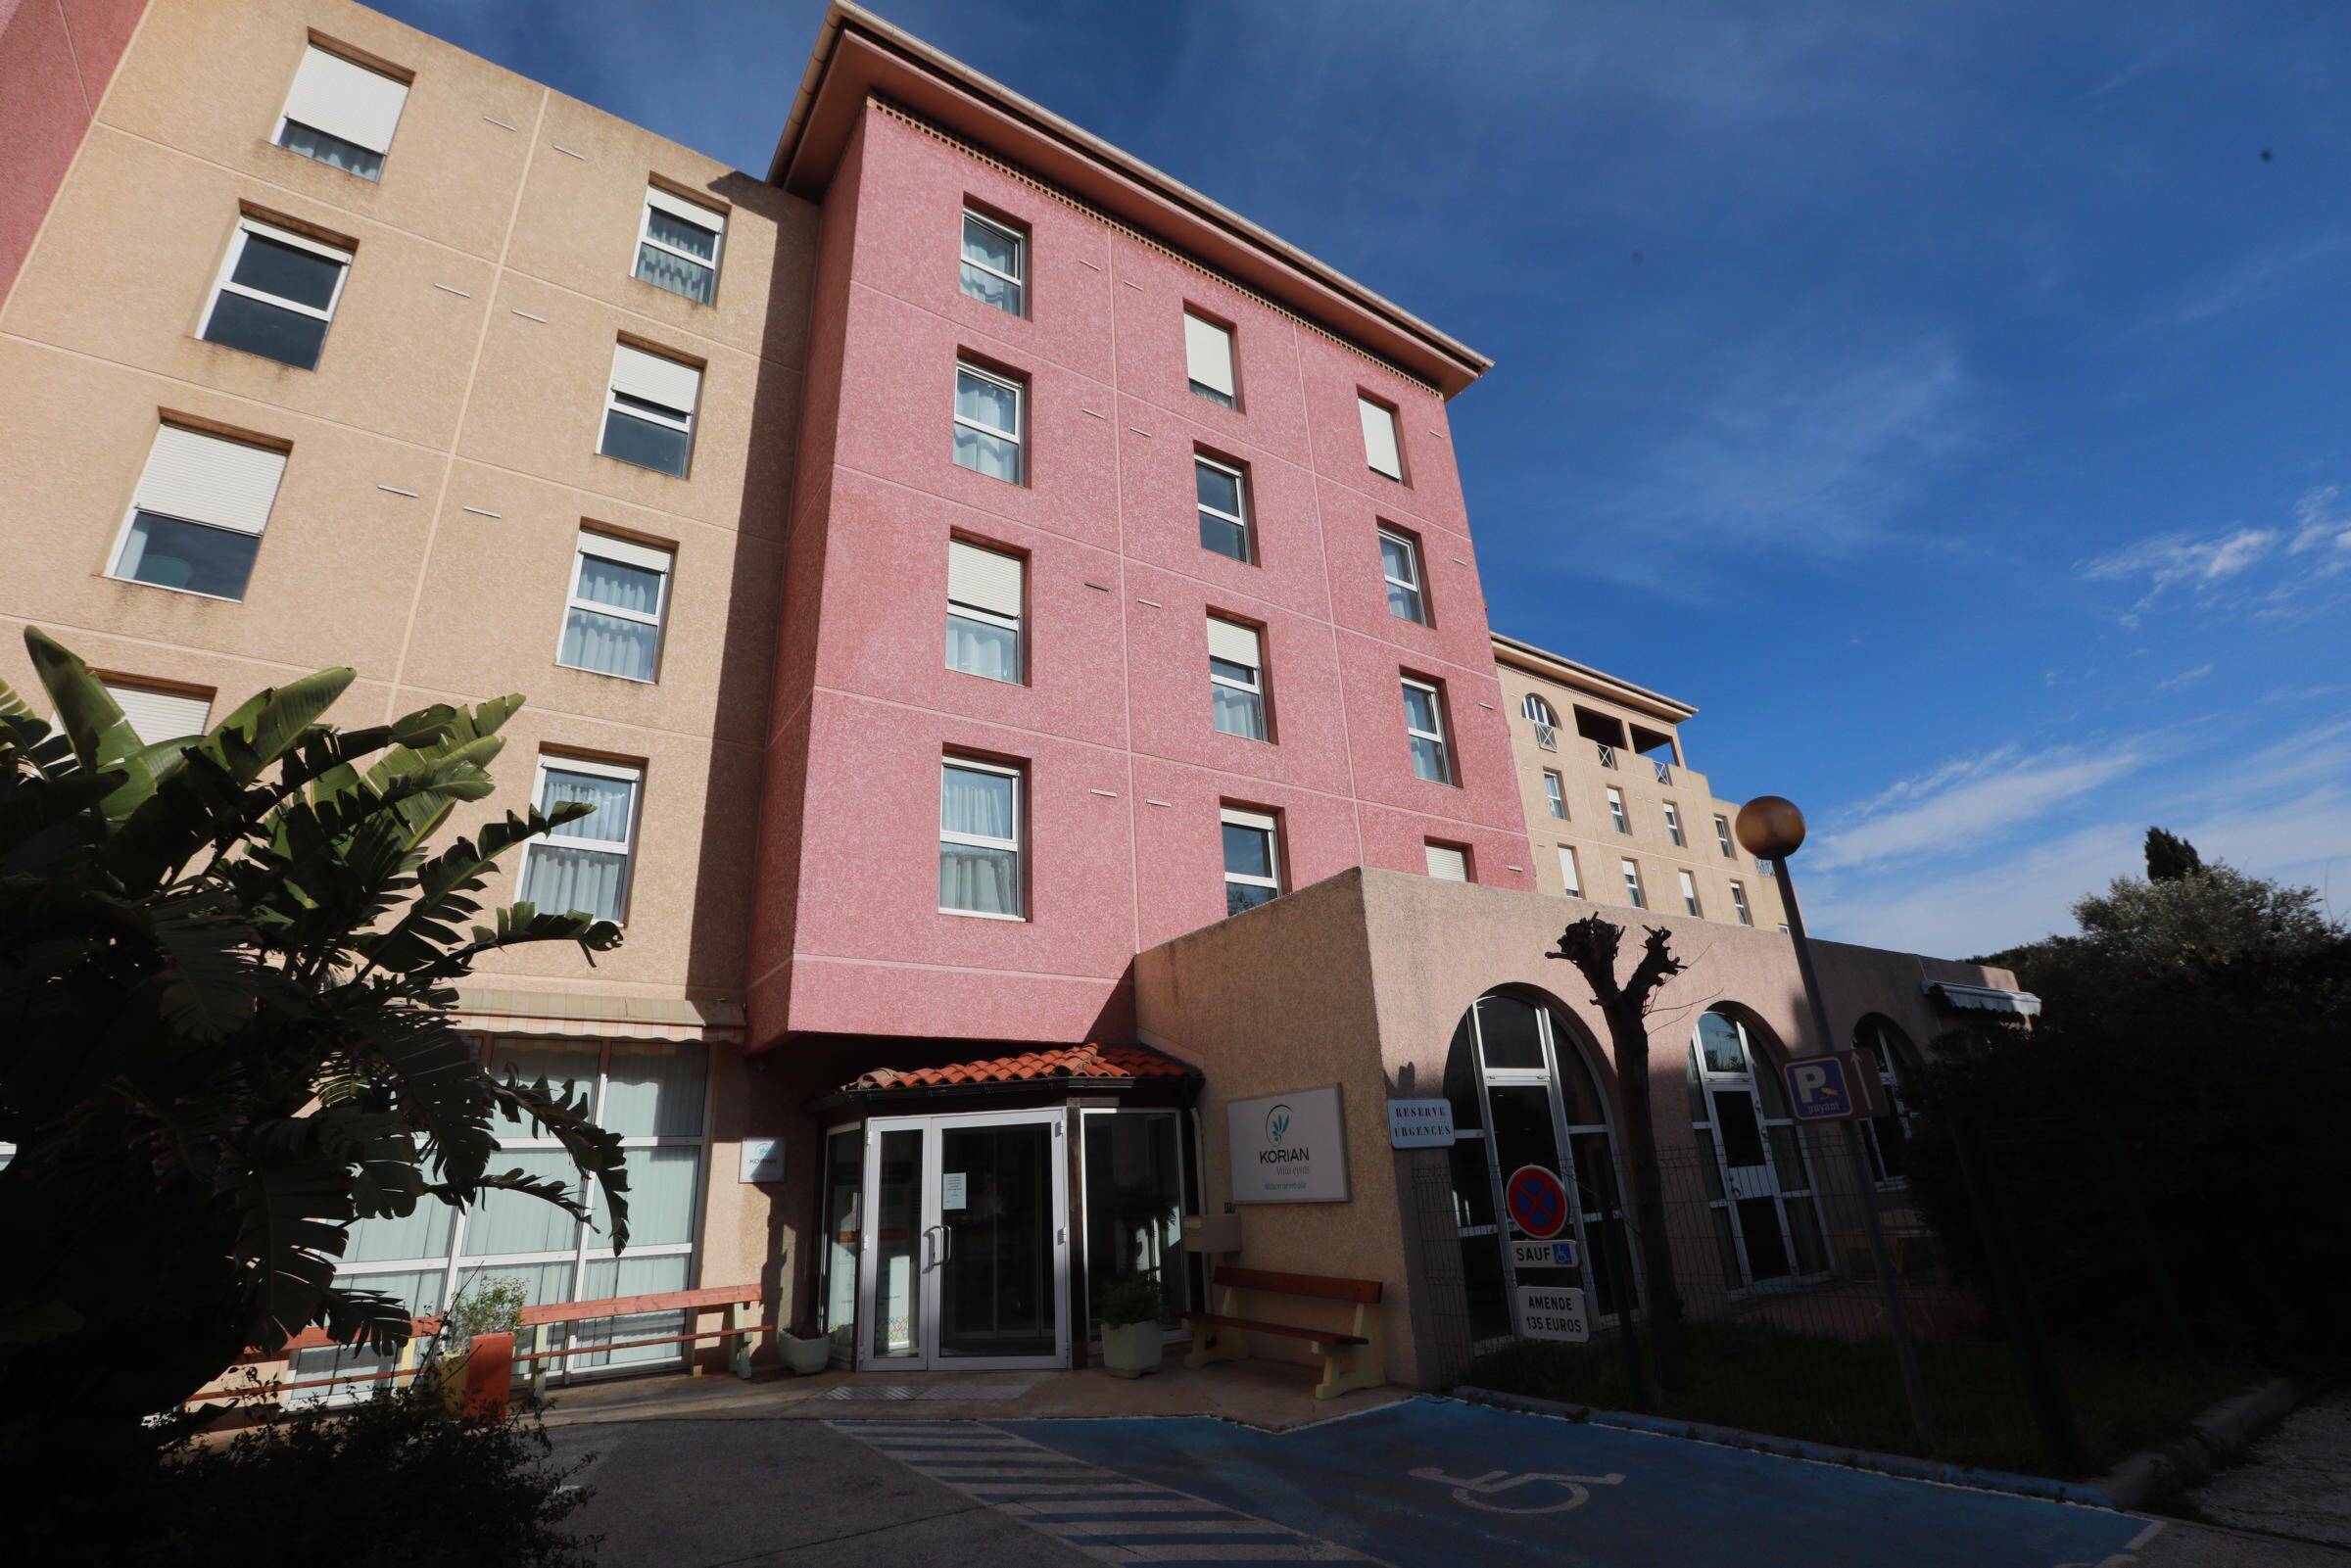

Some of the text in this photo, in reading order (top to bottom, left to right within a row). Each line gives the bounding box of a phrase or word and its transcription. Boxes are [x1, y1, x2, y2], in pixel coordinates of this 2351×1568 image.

[1794, 1066, 1826, 1104] P
[1394, 1125, 1451, 1137] URGENCES
[1259, 1147, 1310, 1164] KORIAN
[1516, 1247, 1550, 1261] SAUF
[1528, 1296, 1573, 1311] AMENDE
[1526, 1315, 1582, 1333] 135 EUROS
